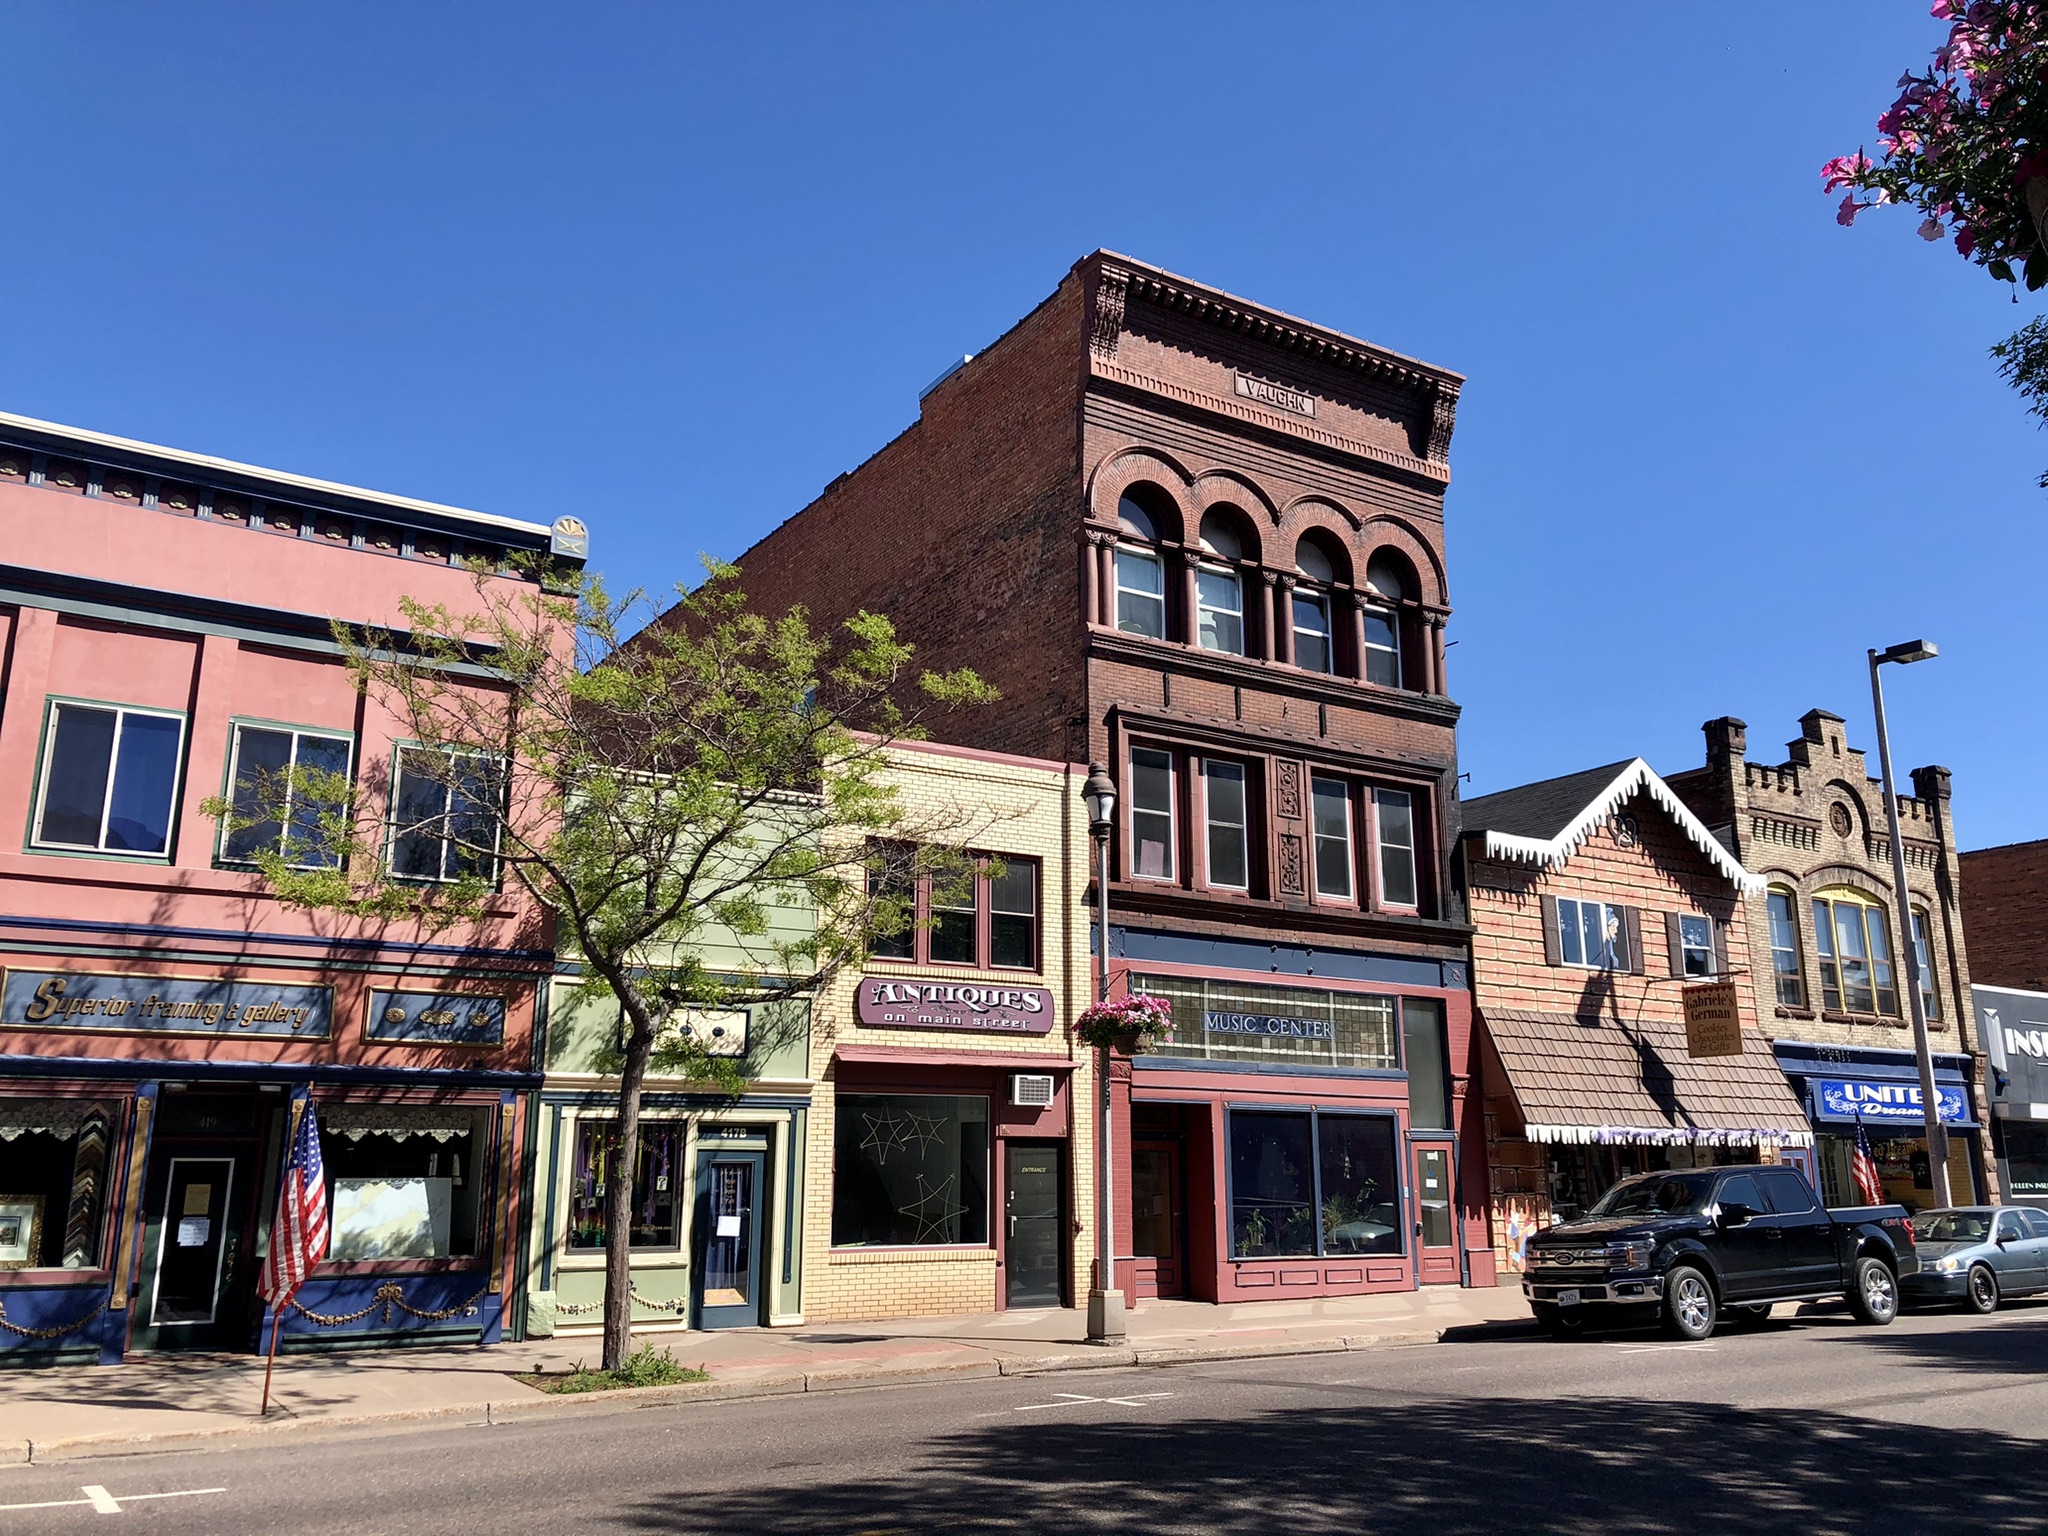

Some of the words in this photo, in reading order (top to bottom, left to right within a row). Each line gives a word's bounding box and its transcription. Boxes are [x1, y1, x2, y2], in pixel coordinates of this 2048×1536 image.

[1245, 379, 1305, 411] VAUGHN
[26, 978, 135, 1021] Superior
[226, 1003, 240, 1021] &
[240, 1001, 310, 1028] gallery
[871, 982, 1044, 1014] ANTIQUES
[1686, 993, 1735, 1010] Gabriele's
[884, 1013, 907, 1023] on
[918, 1011, 963, 1025] main
[973, 1017, 1031, 1031] street
[1690, 1009, 1731, 1021] German
[1206, 1013, 1257, 1032] MUSIC
[1267, 1018, 1332, 1037] CENTER
[1697, 1023, 1729, 1033] Cookies
[1692, 1033, 1736, 1043] Chocolates
[1699, 1043, 1708, 1052] &
[1709, 1041, 1731, 1053] Gifts
[1860, 1102, 1927, 1116] Dream
[198, 1117, 218, 1128] 419
[721, 1127, 747, 1138] 417B
